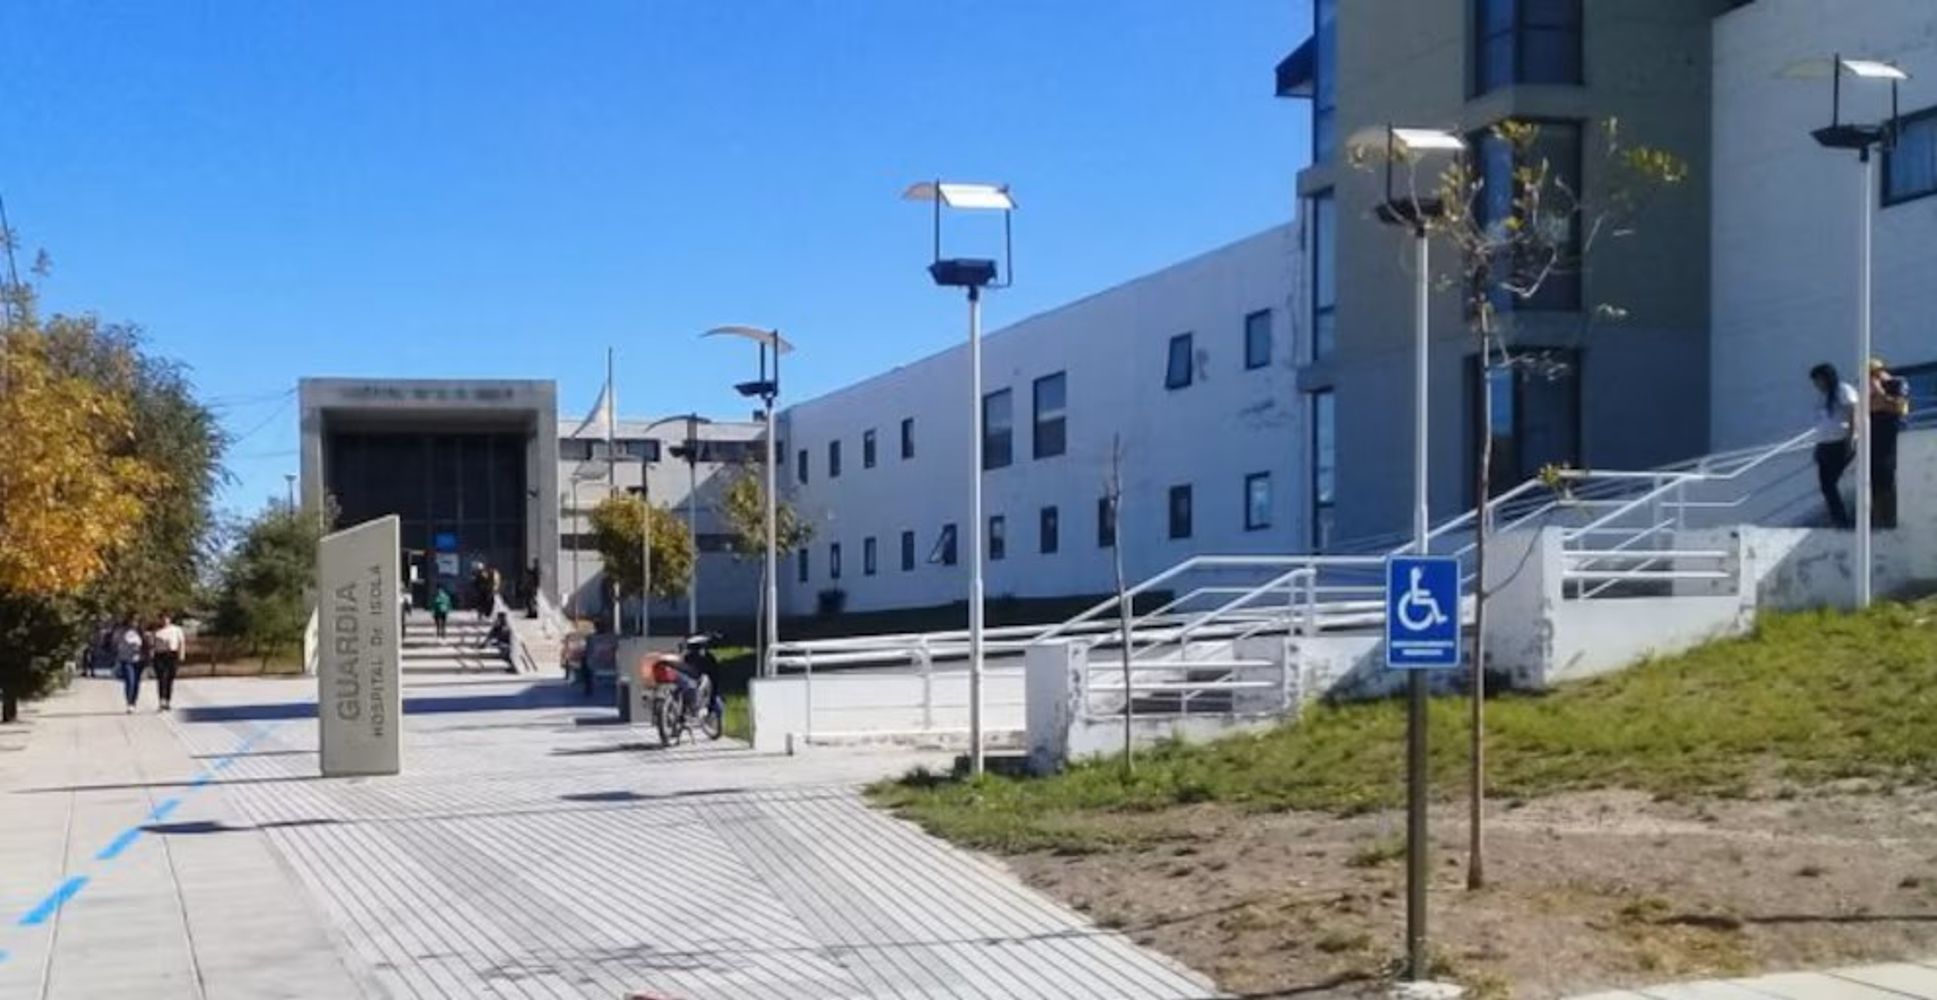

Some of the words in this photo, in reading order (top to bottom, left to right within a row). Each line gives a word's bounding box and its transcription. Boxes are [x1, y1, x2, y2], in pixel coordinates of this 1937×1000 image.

[369, 564, 383, 616] ISOLA
[335, 581, 360, 721] GUARDIA
[370, 660, 385, 737] HOSPITAL
